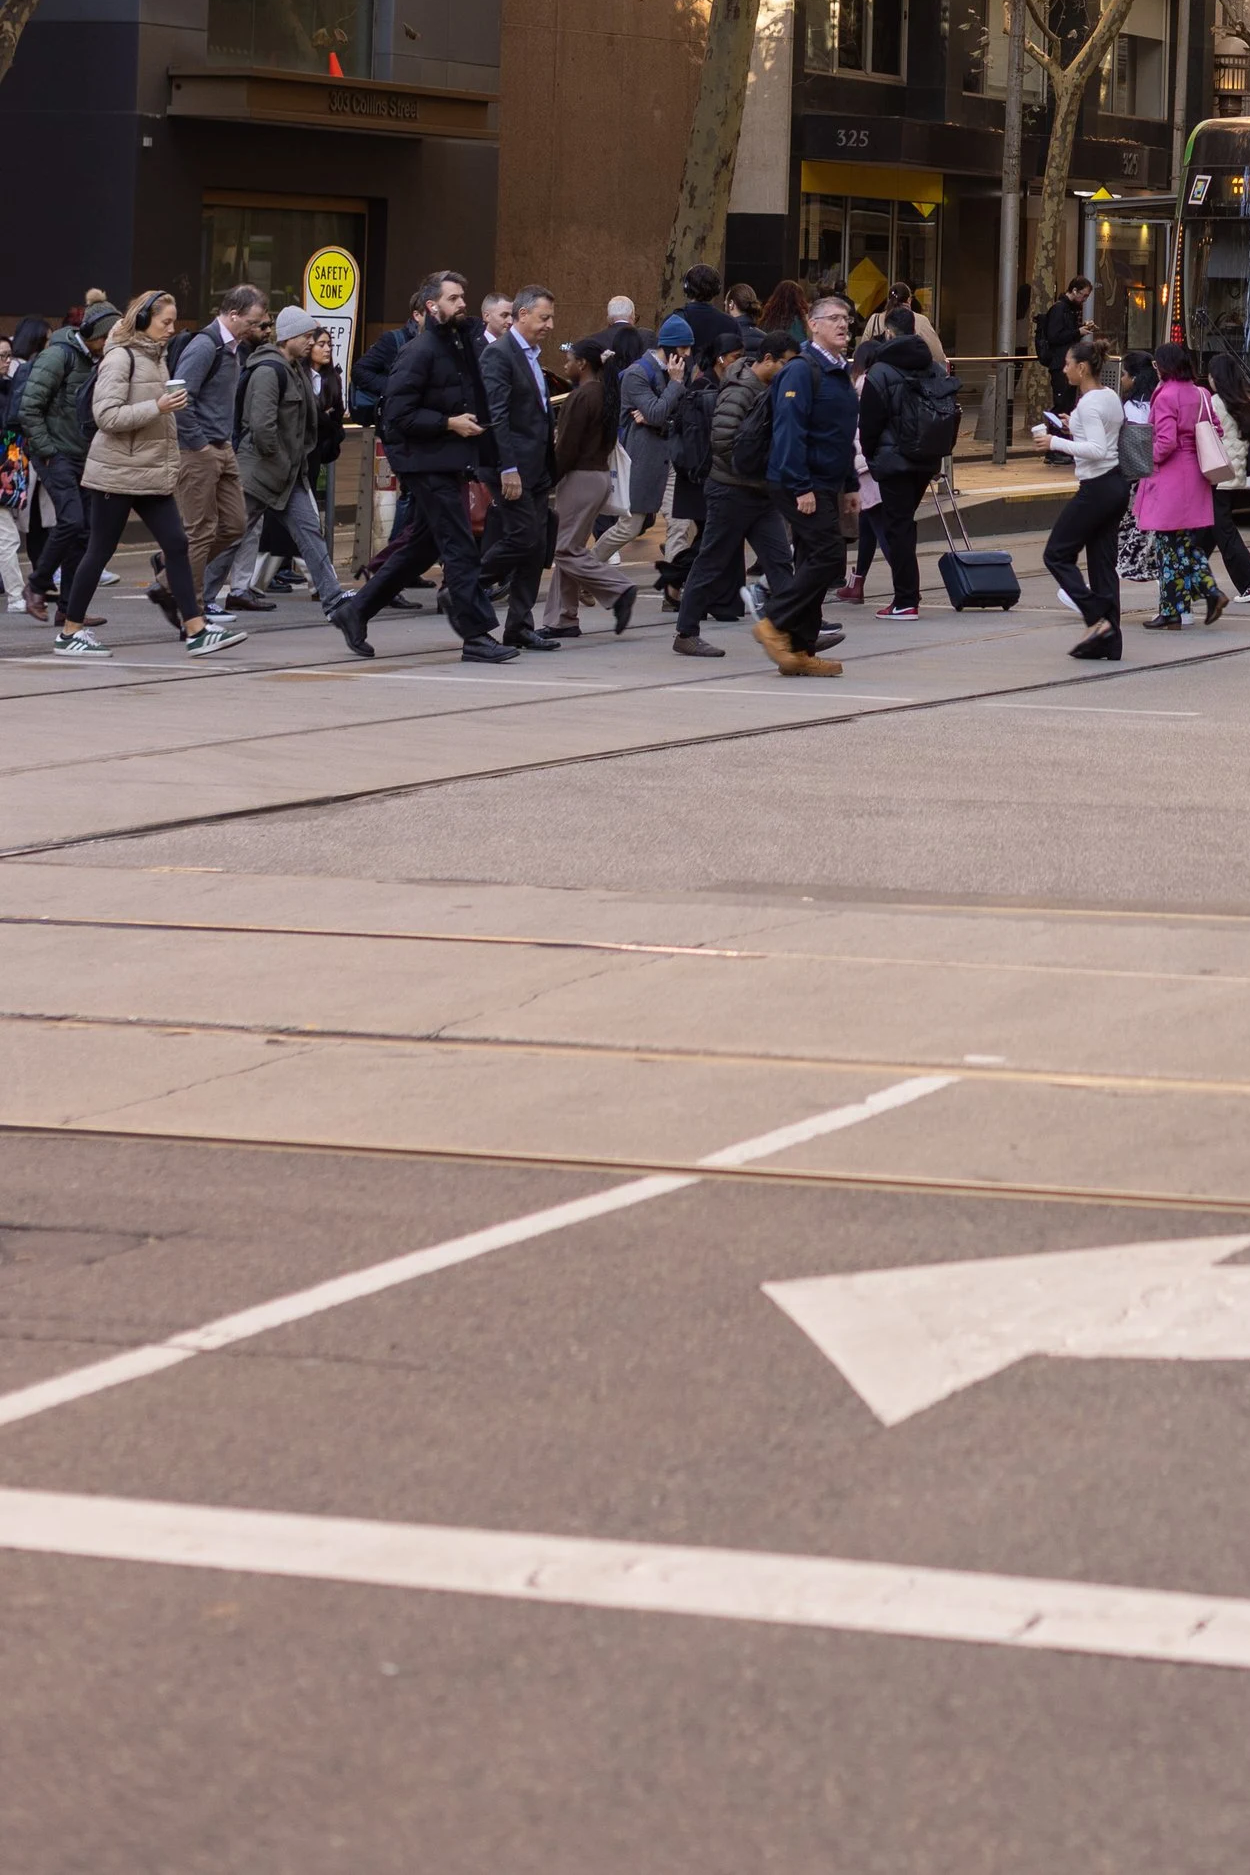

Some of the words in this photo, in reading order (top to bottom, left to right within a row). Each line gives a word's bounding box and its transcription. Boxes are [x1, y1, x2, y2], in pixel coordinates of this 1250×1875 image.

[330, 91, 350, 111] 303
[352, 94, 388, 116] Collins
[390, 96, 420, 119] Street
[836, 129, 869, 147] 325
[315, 266, 349, 281] SAFETY
[320, 284, 343, 299] ZONE
